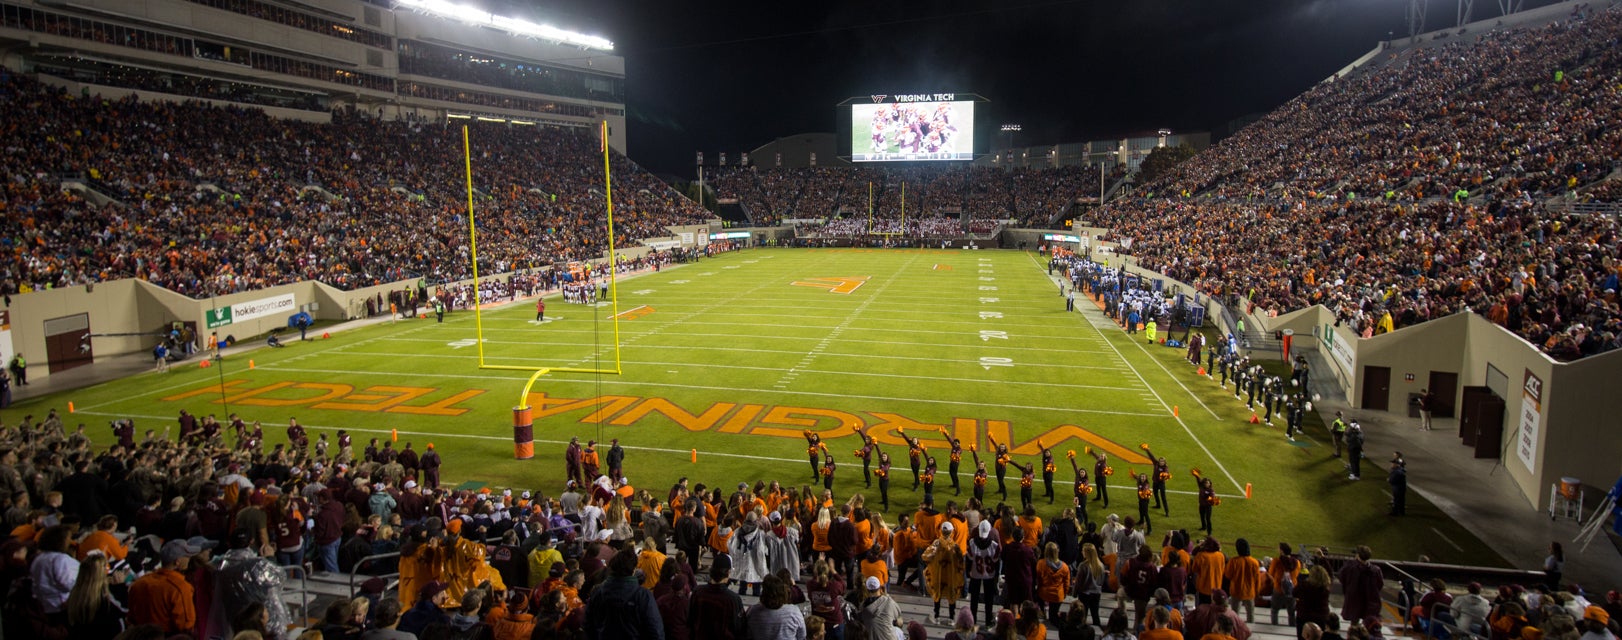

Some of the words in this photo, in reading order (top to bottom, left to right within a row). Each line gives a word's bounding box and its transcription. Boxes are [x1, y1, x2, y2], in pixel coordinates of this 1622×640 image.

[871, 95, 887, 103] VT
[894, 94, 932, 102] VIRGINIA
[933, 93, 954, 101] TECH
[235, 299, 293, 317] hokiesports.com
[979, 356, 1015, 368] 10
[1525, 375, 1541, 398] ACC
[160, 379, 488, 417] TECH
[519, 392, 1154, 465] VIRGINIA
[278, 522, 289, 537] 5
